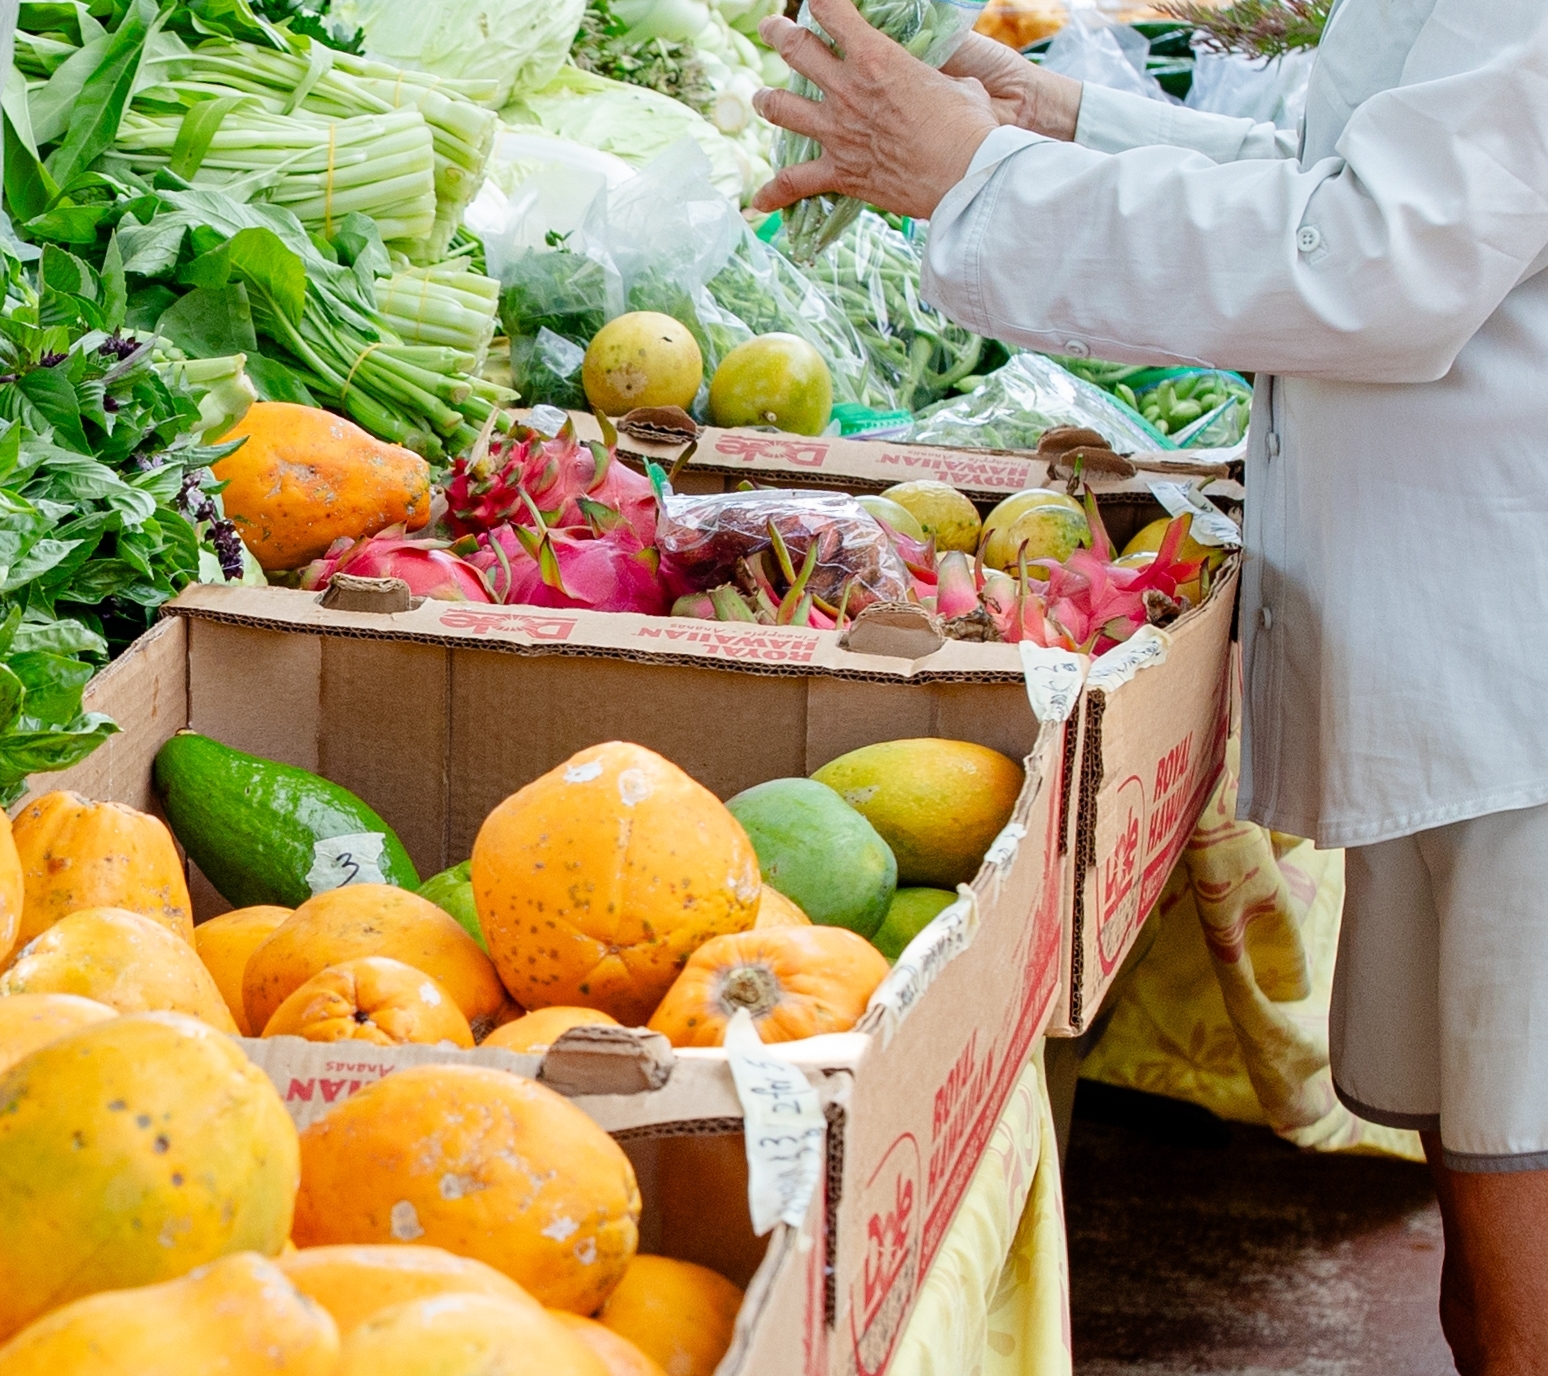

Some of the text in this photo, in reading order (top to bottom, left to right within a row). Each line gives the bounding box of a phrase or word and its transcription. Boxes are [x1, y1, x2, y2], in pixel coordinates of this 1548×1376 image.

[715, 436, 831, 467] Dole
[879, 454, 1030, 478] HAWAIIAN
[934, 471, 1026, 488] ROYAL
[439, 610, 578, 641] Dole
[669, 623, 819, 642] Pineapple Ananas
[637, 627, 818, 651] HAWAIIAN
[701, 643, 813, 662] ROYAL
[1153, 731, 1193, 802] ROYAL
[336, 852, 360, 889] 3
[326, 1061, 395, 1077] Ananas
